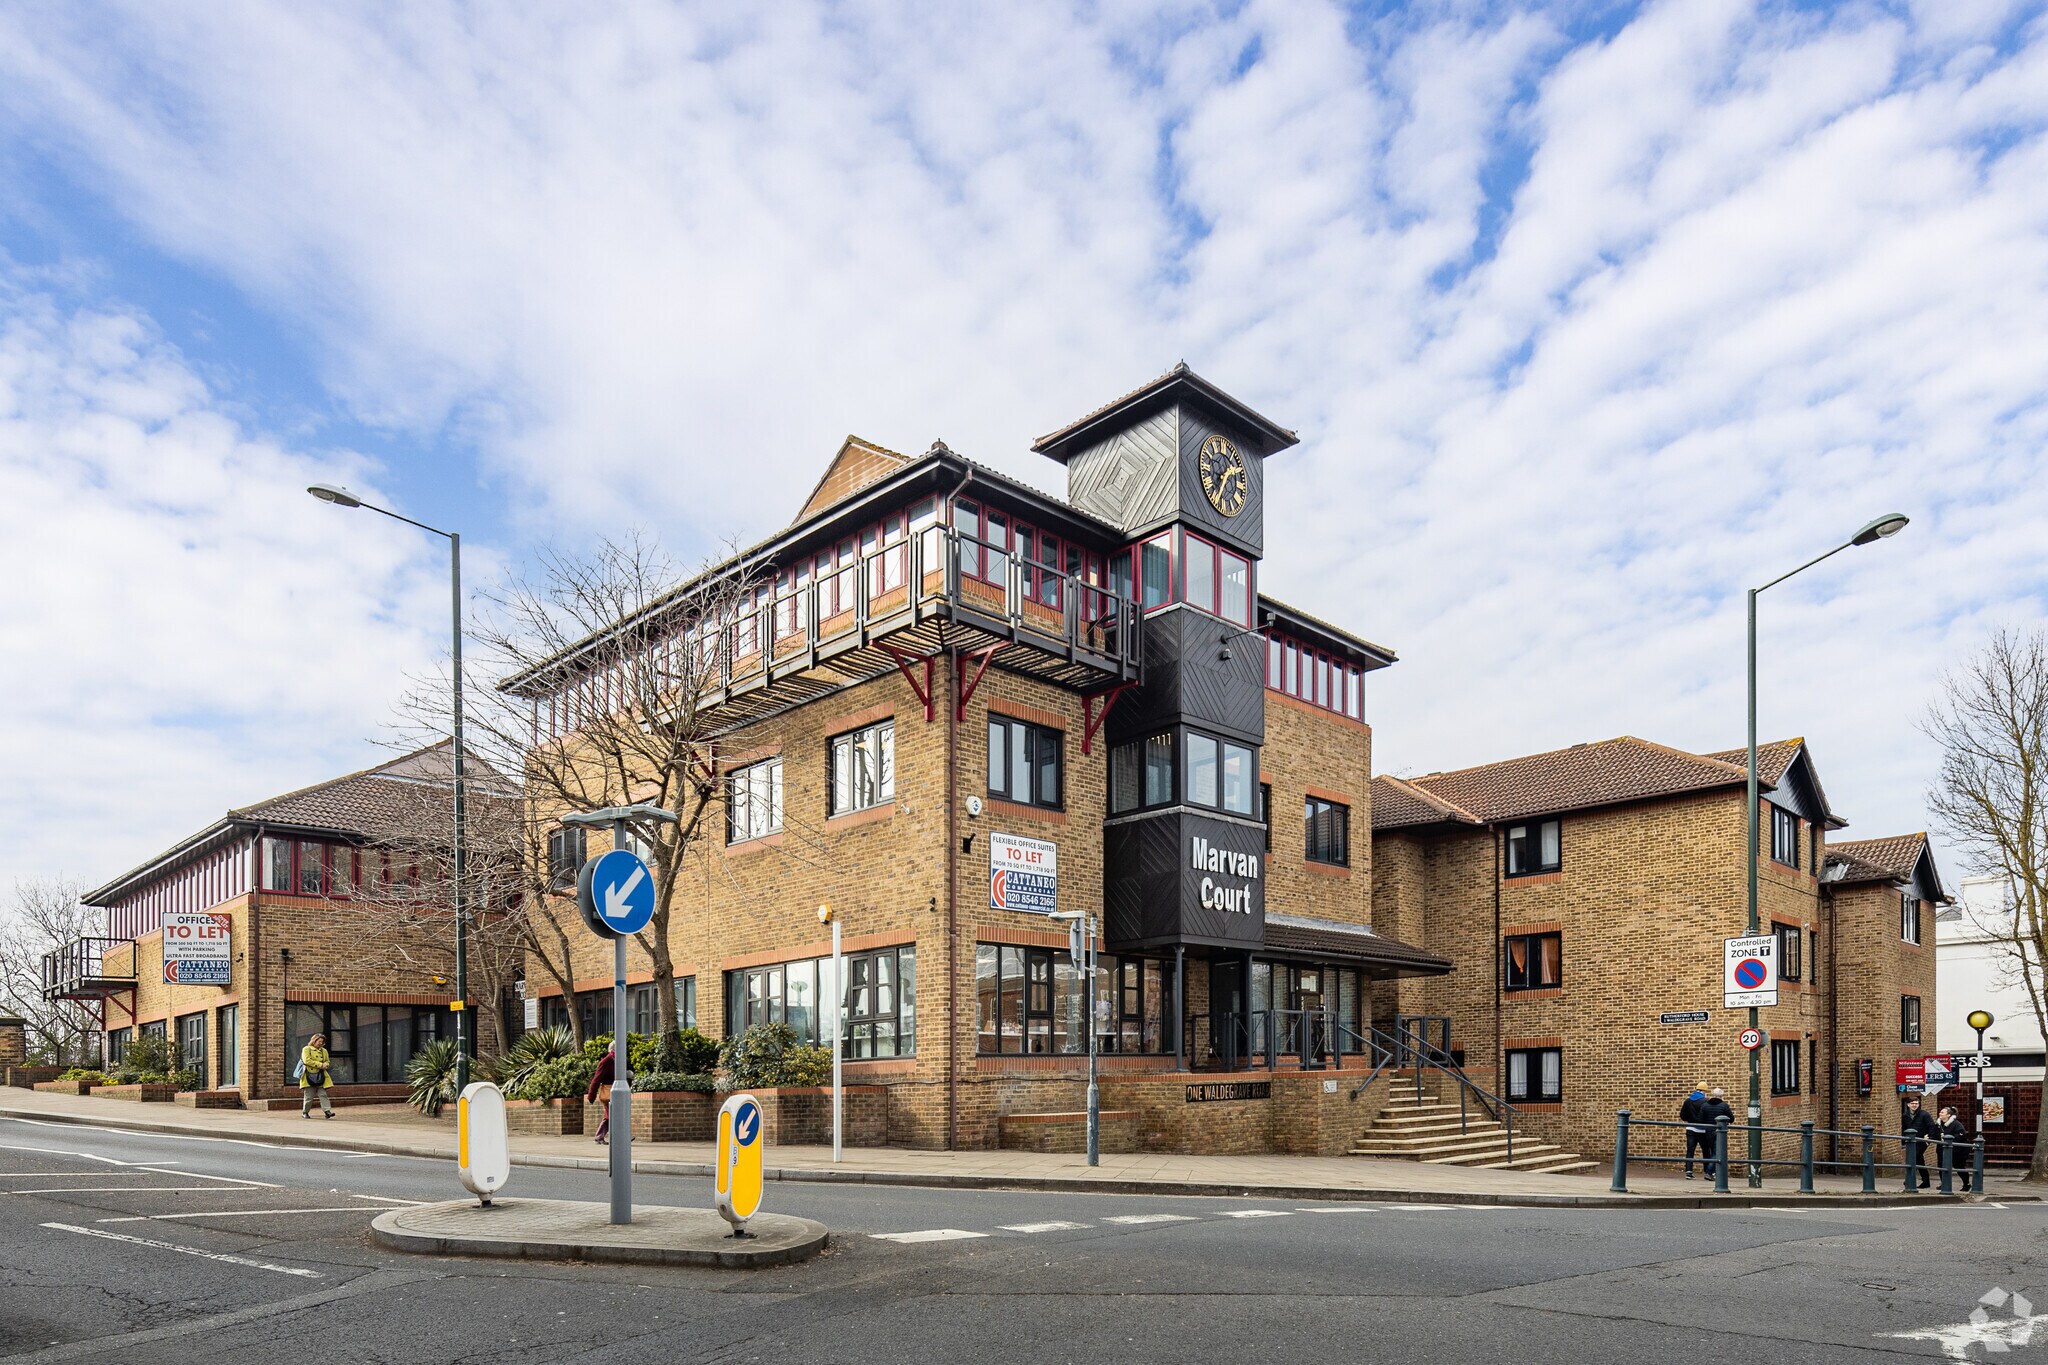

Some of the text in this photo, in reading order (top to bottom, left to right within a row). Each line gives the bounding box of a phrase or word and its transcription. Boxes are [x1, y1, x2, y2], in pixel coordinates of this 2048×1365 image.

[992, 836, 1055, 852] FLEXIBLE OFFICE SUITES
[1006, 848, 1042, 864] TO LET
[1192, 836, 1258, 878] Marvan
[1007, 872, 1055, 889] CATTANEO
[1006, 884, 1054, 895] COMMERCIAL
[1201, 877, 1250, 914] Court
[1007, 892, 1020, 902] 020
[1021, 895, 1038, 905] 8546
[167, 926, 224, 938] TO LET
[1730, 938, 1771, 947] Controlled
[1731, 947, 1769, 958] ZONE T
[1743, 1034, 1757, 1043] 20
[1187, 1086, 1202, 1101] ONE
[1204, 1084, 1250, 1100] WALDEGRAVE
